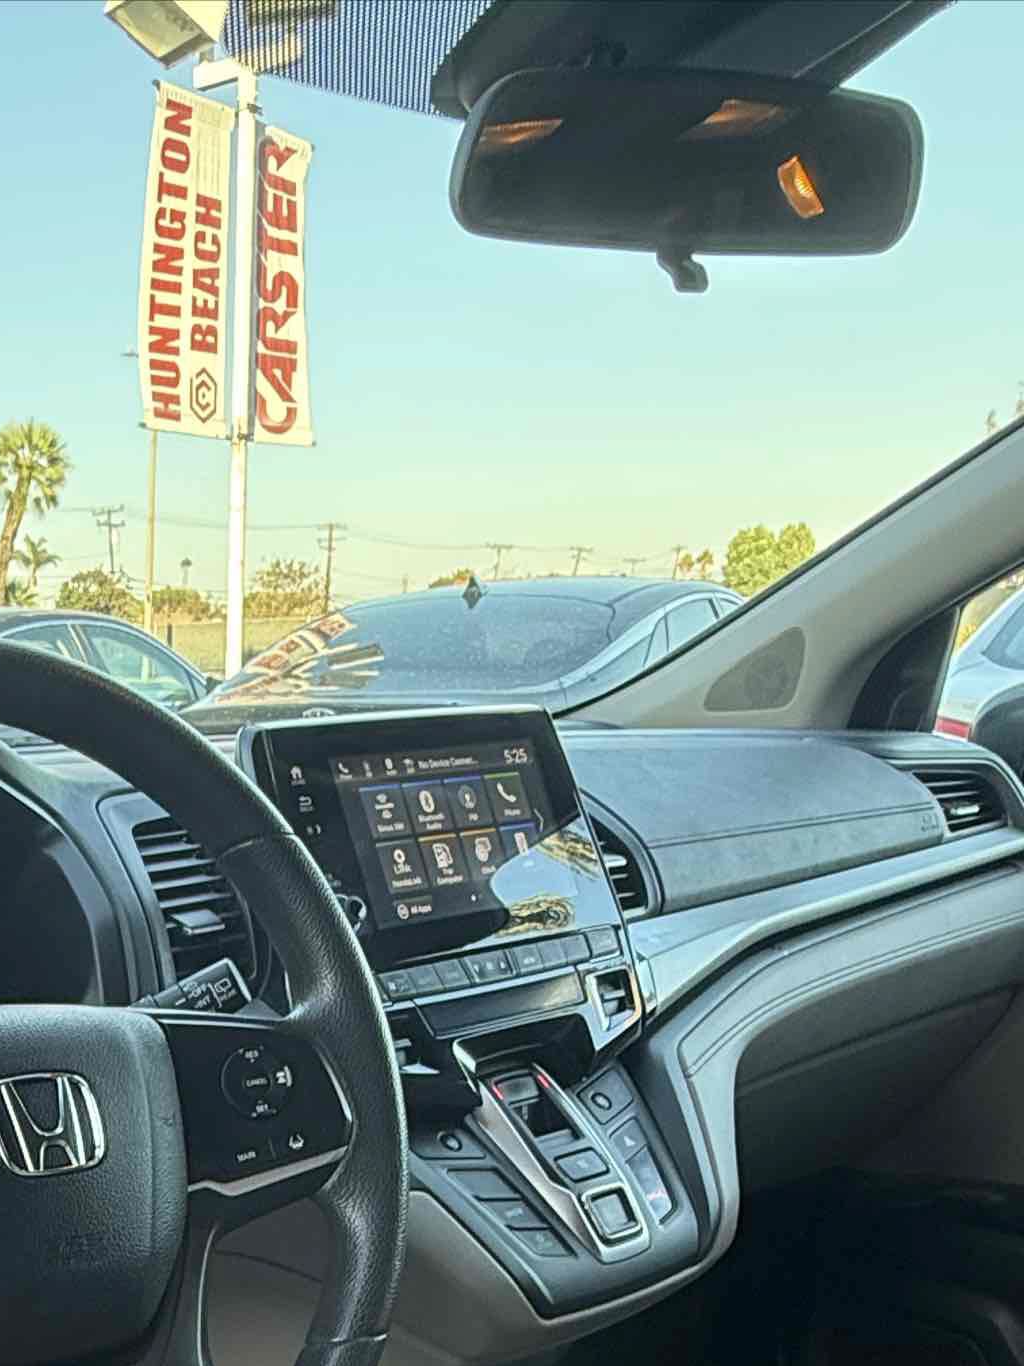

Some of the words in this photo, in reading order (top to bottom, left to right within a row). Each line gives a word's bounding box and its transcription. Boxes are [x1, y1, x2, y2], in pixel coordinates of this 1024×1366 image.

[148, 98, 193, 422] HUNTINGTON
[190, 192, 222, 355] BEACH
[255, 135, 300, 436] CARSTER
